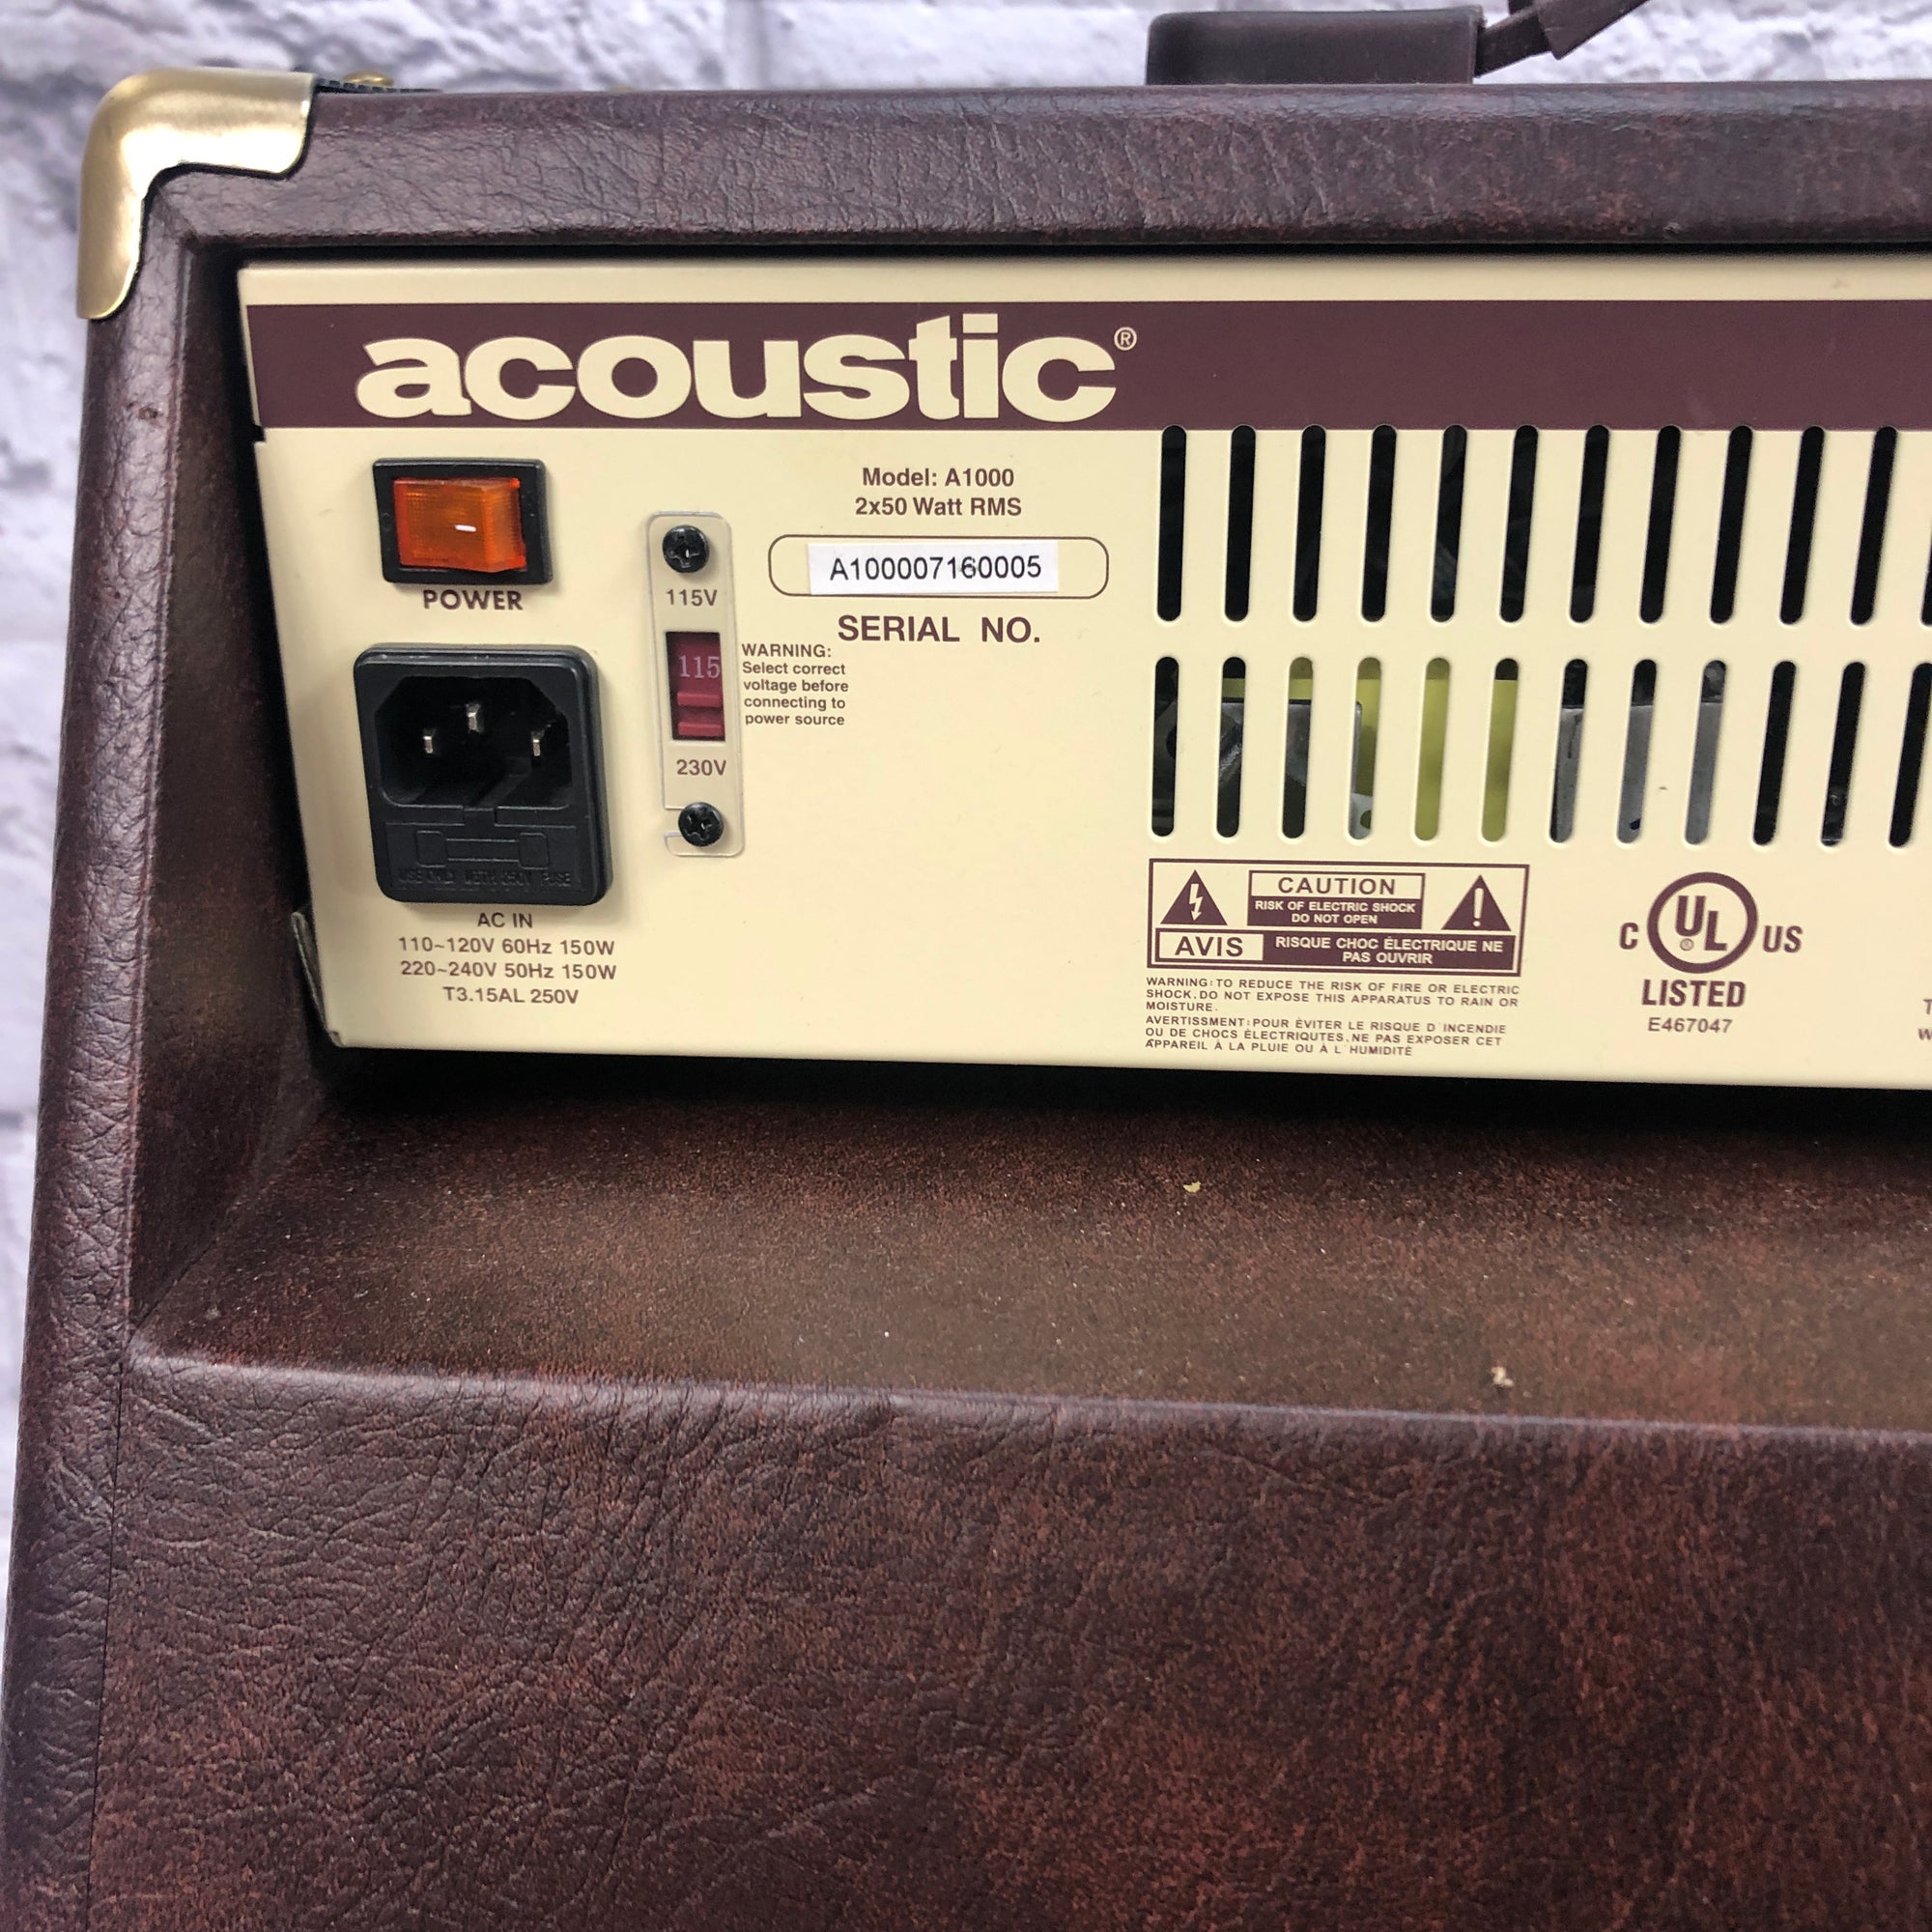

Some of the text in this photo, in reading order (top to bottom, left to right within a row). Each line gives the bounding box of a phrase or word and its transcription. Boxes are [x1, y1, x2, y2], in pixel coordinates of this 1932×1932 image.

[356, 314, 1116, 422] acoustic
[863, 468, 1013, 487] Model: A1000
[856, 497, 1021, 516] 2x50 Watt RMS
[831, 555, 1040, 581] A100007160005
[422, 590, 525, 611] POWER
[668, 589, 717, 606] 115V
[838, 615, 1039, 642] SERIAL NO.
[742, 643, 831, 657] WARNING:
[678, 655, 721, 678] 115
[742, 662, 846, 675] Select correct
[744, 679, 849, 694] voltage before
[745, 696, 846, 711] connecting to
[745, 714, 845, 726] power source
[677, 759, 726, 776] 230V
[1278, 877, 1395, 895] CAUTION
[1255, 899, 1416, 913] RISK OF ELECTRIC SHOCK
[477, 914, 533, 927] AC IN
[1291, 913, 1378, 924] DO NOT OPEN
[1675, 895, 1727, 951] UL
[1763, 925, 1803, 952] US
[398, 936, 614, 955] 110~120V 60Hz 150W
[1175, 936, 1242, 956] AVIS
[1275, 936, 1504, 952] RISQUE CHOC ÉLECTRIQUE NE
[1342, 952, 1434, 964] PAS OUVRIR
[400, 960, 616, 980] 220~240V 50Hz 150W
[442, 986, 579, 1004] T3.15AL 250V
[1146, 977, 1520, 995] WARNING: TO REDUCE THE RISK OF FIRE OR ELECTRIC
[1642, 980, 1746, 1007] LISTED
[1199, 990, 1218, 1000] DO
[1224, 990, 1251, 1001] NOT
[1256, 991, 1310, 1003] EXPOSE
[1315, 993, 1346, 1004] THIS
[1350, 994, 1432, 1006] APPARATUS
[1436, 996, 1456, 1007] TO
[1461, 996, 1493, 1007] RAIN
[1498, 997, 1519, 1008] OR
[1252, 1018, 1290, 1029] POUR
[1348, 1020, 1364, 1031] LE
[1370, 1021, 1420, 1033] RISQUE
[1648, 1017, 1732, 1033] E467047
[1145, 1027, 1164, 1037] OU
[1169, 1028, 1186, 1037] DE
[1192, 1028, 1238, 1039] CHOCS
[1351, 1033, 1370, 1043] NE
[1375, 1034, 1401, 1044] PAS
[1406, 1034, 1470, 1045] EXPOSER
[1475, 1036, 1502, 1046] CET
[1229, 1041, 1245, 1051] LA
[1251, 1042, 1289, 1053] PLUIE
[1294, 1043, 1314, 1054] OU
